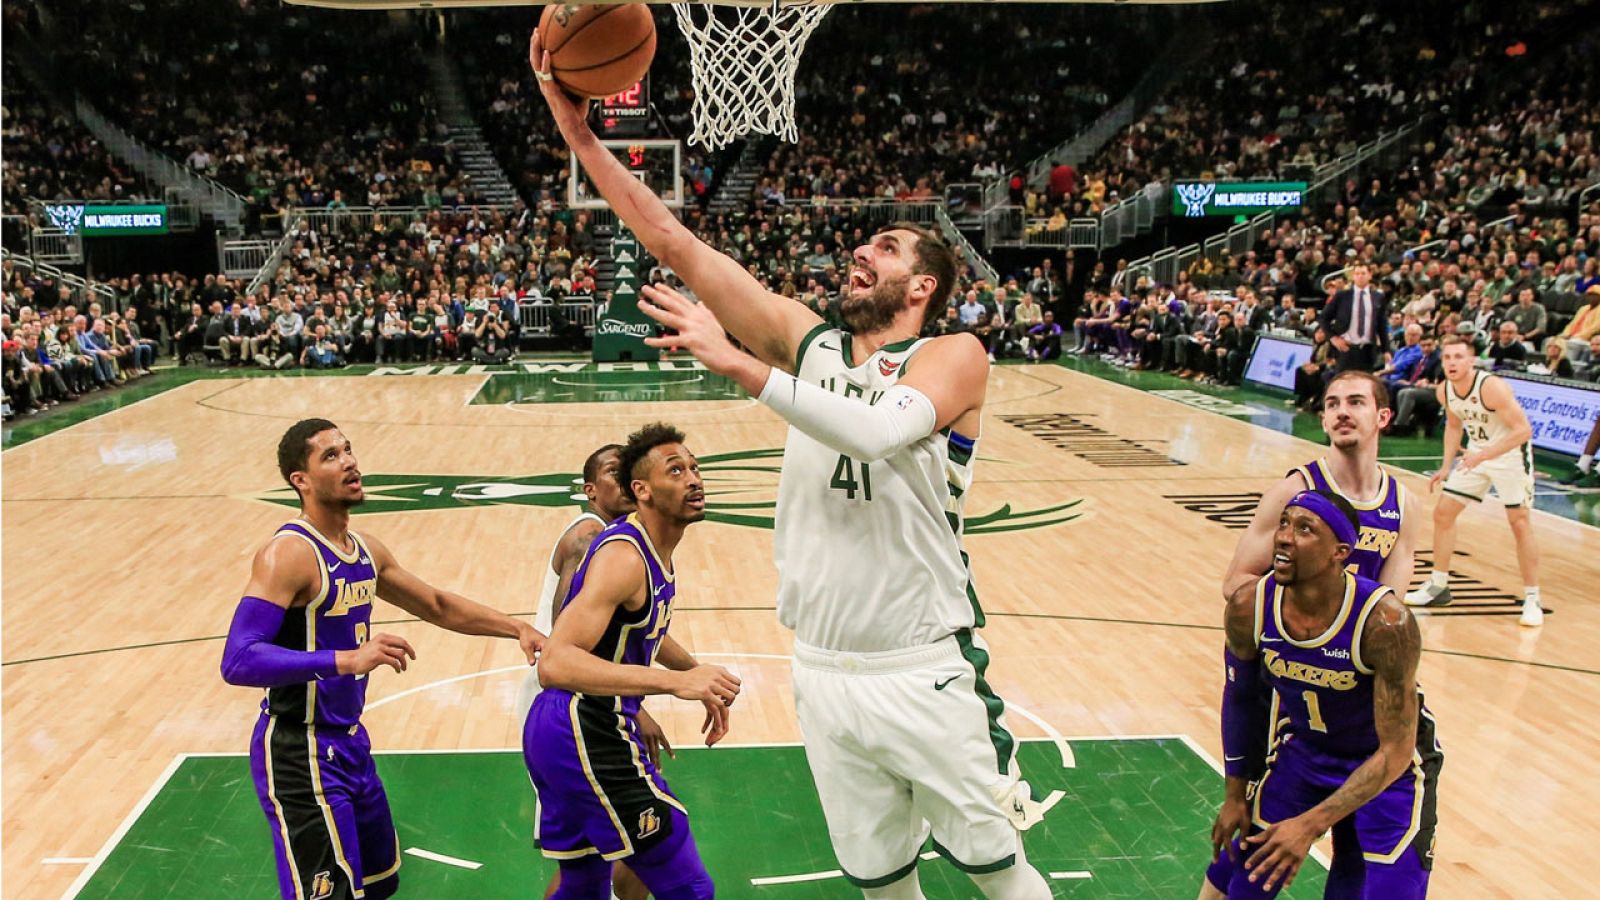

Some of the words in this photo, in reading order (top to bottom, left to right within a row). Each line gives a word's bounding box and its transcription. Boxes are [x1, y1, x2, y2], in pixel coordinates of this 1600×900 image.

[1214, 192, 1266, 207] MILWAUKEE
[1267, 190, 1301, 206] BUCKS
[84, 213, 132, 227] MILWAUKEE
[133, 213, 161, 226] BUCKS
[598, 319, 651, 338] SARGENTO
[1541, 396, 1589, 421] Controls
[1545, 420, 1589, 444] Partner
[830, 453, 872, 501] 41
[1378, 508, 1400, 520] wish
[1321, 647, 1350, 660] wish
[1262, 648, 1358, 692] LAKERS
[1303, 690, 1328, 734] 1
